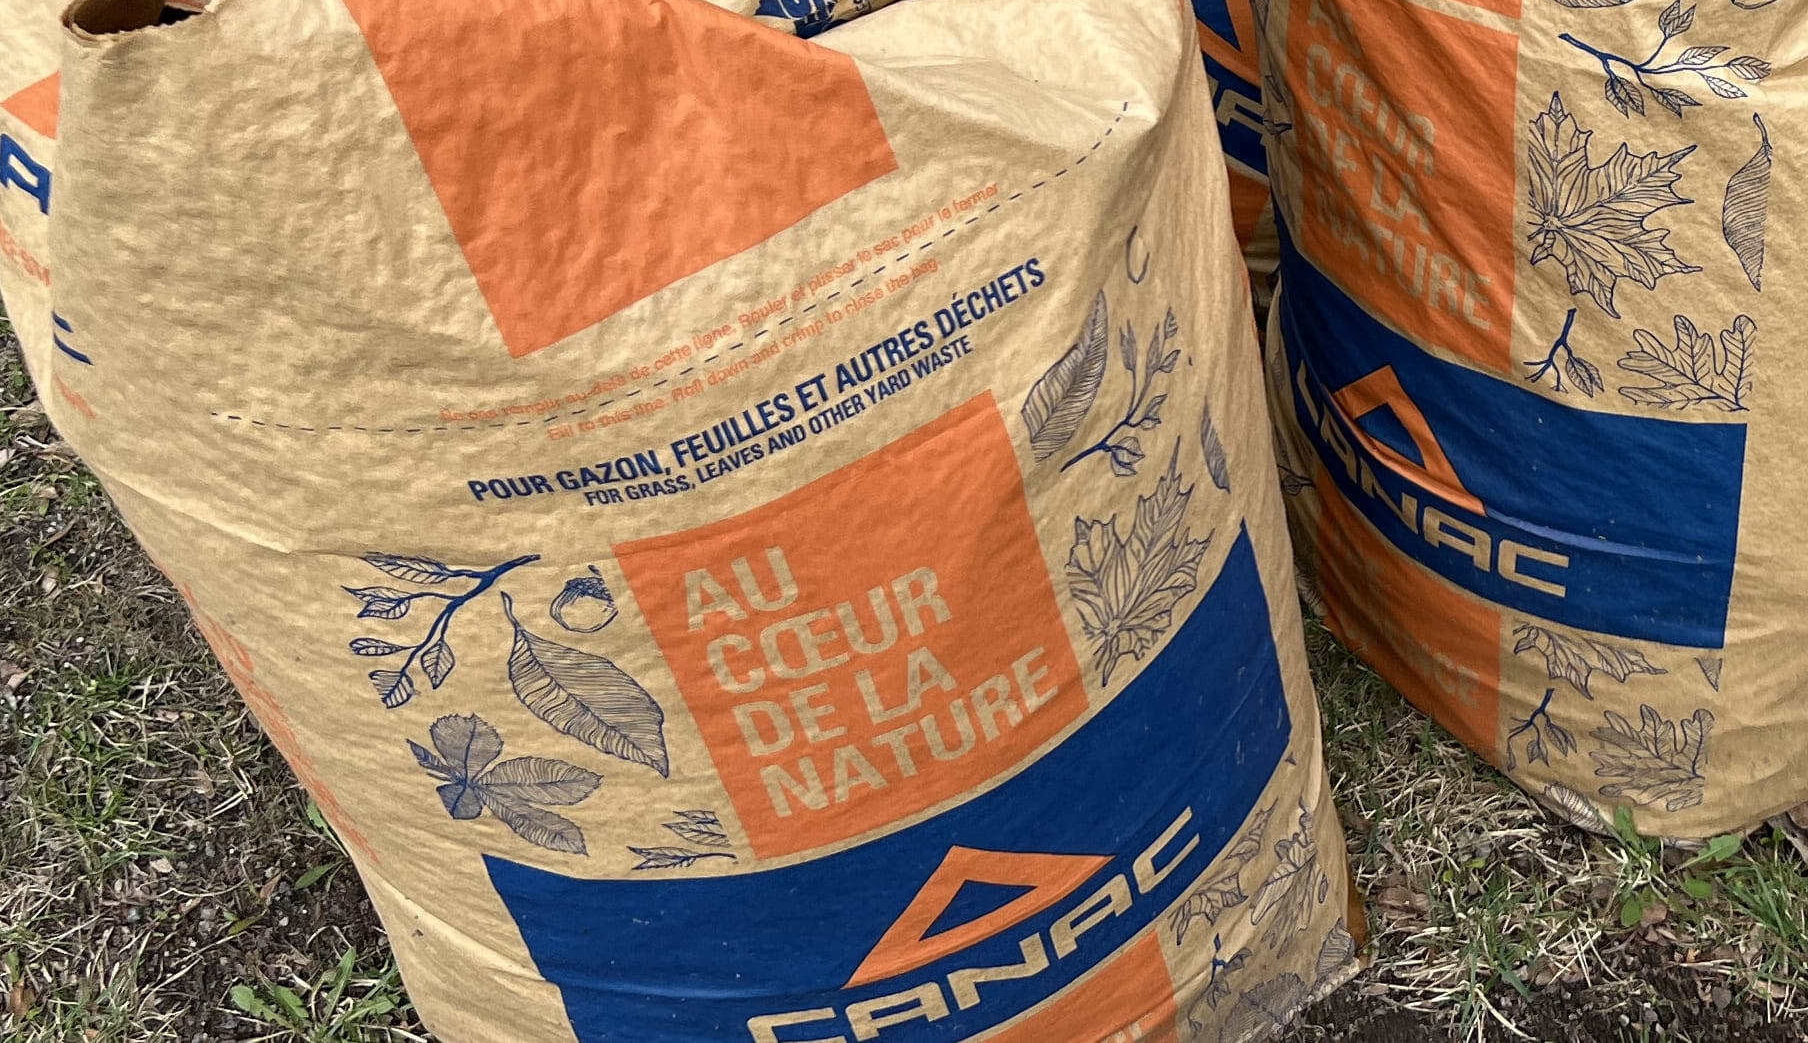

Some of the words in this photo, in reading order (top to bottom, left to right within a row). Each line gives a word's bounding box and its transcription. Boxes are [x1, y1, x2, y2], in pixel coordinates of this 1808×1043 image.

[467, 474, 556, 502] POUR
[554, 448, 672, 492] GAZON,
[669, 392, 798, 470] FEUILLES
[794, 373, 830, 413] ET
[834, 320, 936, 395] AUTRES
[933, 257, 1046, 340] DÉCHETS
[578, 419, 597, 435] to
[599, 409, 632, 429] this
[670, 380, 704, 404] Roll
[705, 357, 751, 389] down
[751, 340, 782, 367] and
[782, 320, 826, 353] crimp
[826, 310, 844, 327] to
[844, 288, 886, 318] close
[885, 274, 911, 295] the
[630, 363, 651, 381] de
[653, 342, 693, 372] cette
[737, 296, 789, 328] Rouler
[807, 259, 858, 297] plisser
[856, 246, 872, 265] le
[873, 236, 901, 258] sac
[902, 214, 937, 246] pour
[938, 206, 953, 223] le
[584, 483, 626, 508] FOR
[625, 474, 698, 502] GRASS,
[696, 442, 766, 485] LEAVES
[767, 424, 808, 456] AND
[808, 392, 868, 437] OTHER
[863, 368, 913, 406] YARD
[910, 334, 975, 380] WASTE
[683, 545, 799, 633] AU
[705, 566, 953, 694] CŒUR
[730, 682, 849, 758] DE
[853, 645, 959, 726] LA
[758, 645, 1060, 820] NATURE
[746, 805, 1201, 1043] CANAC
